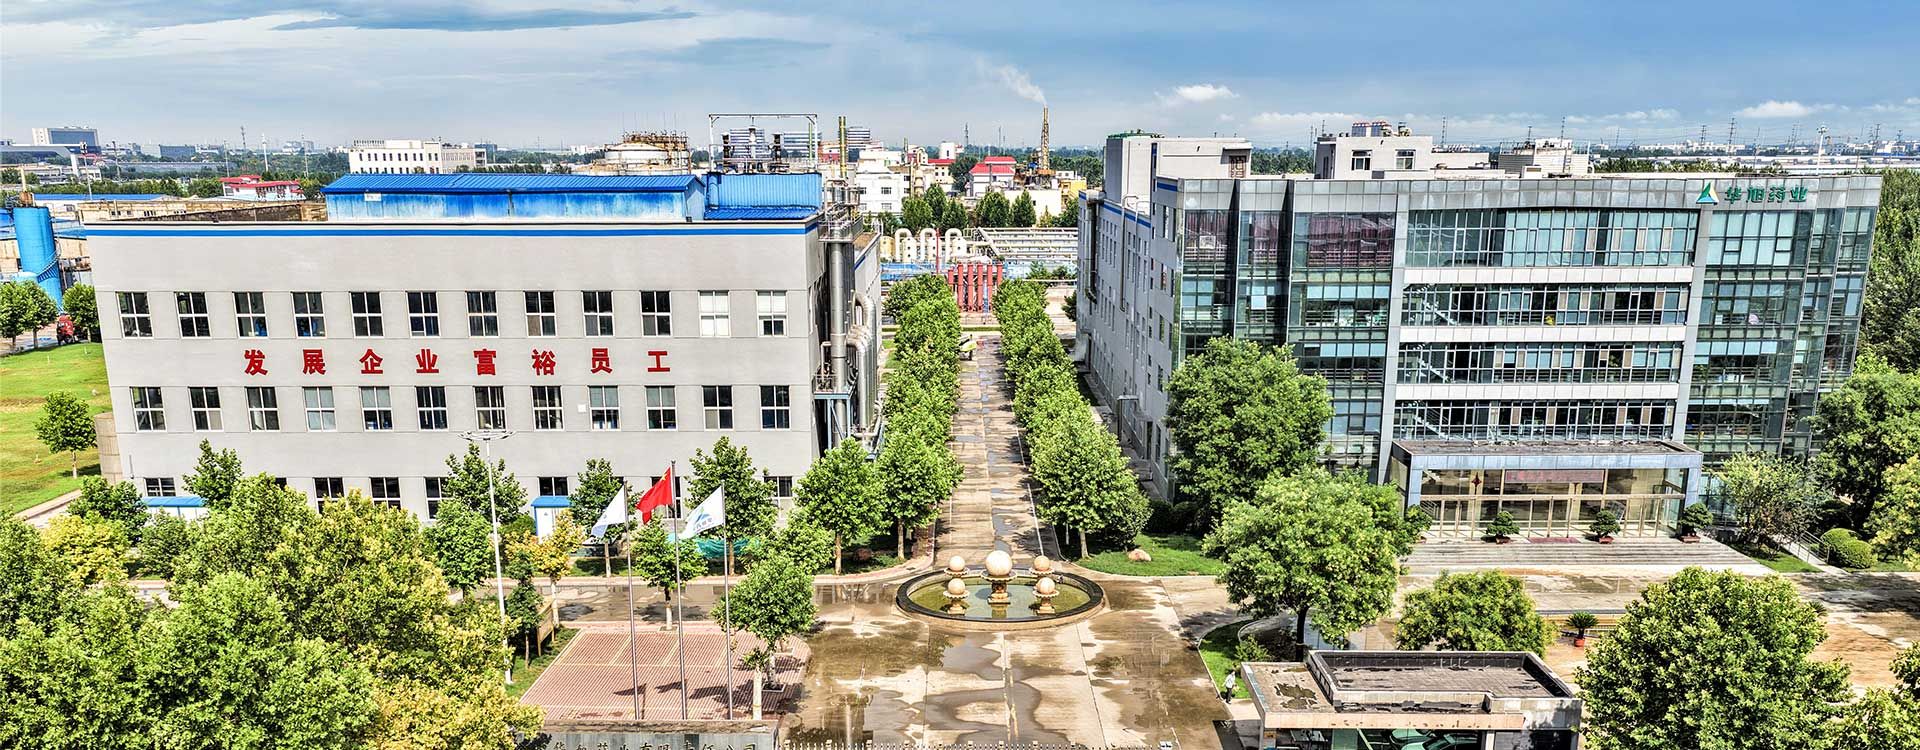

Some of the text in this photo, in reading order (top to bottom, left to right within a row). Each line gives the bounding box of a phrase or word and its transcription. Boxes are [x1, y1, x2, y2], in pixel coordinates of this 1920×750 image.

[1724, 185, 1808, 204] 华旭药业
[243, 348, 671, 376] 发展企业富裕员工
